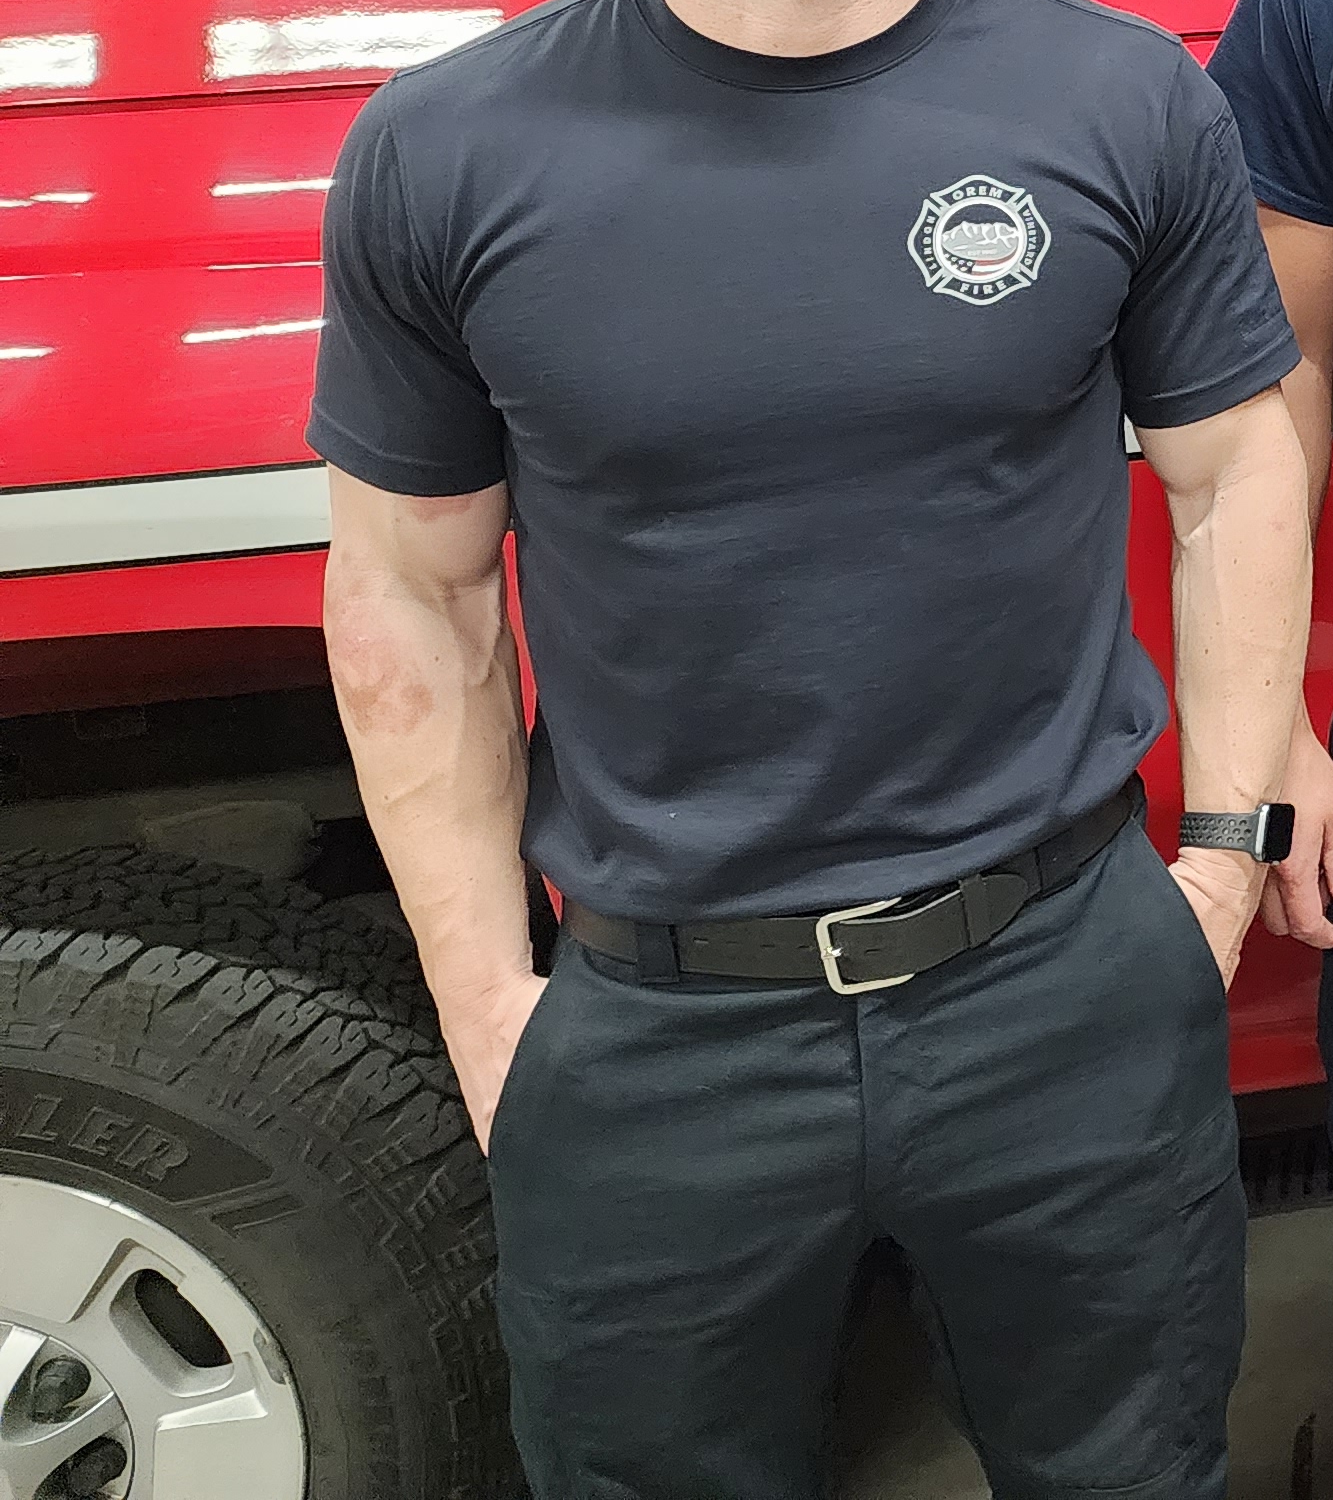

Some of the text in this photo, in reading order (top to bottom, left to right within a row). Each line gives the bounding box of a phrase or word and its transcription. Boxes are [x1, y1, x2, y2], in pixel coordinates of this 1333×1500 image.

[952, 185, 1004, 201] OREM
[922, 215, 937, 271] LINDON
[1022, 208, 1038, 267] VINEYARD
[959, 279, 1008, 295] FIRE
